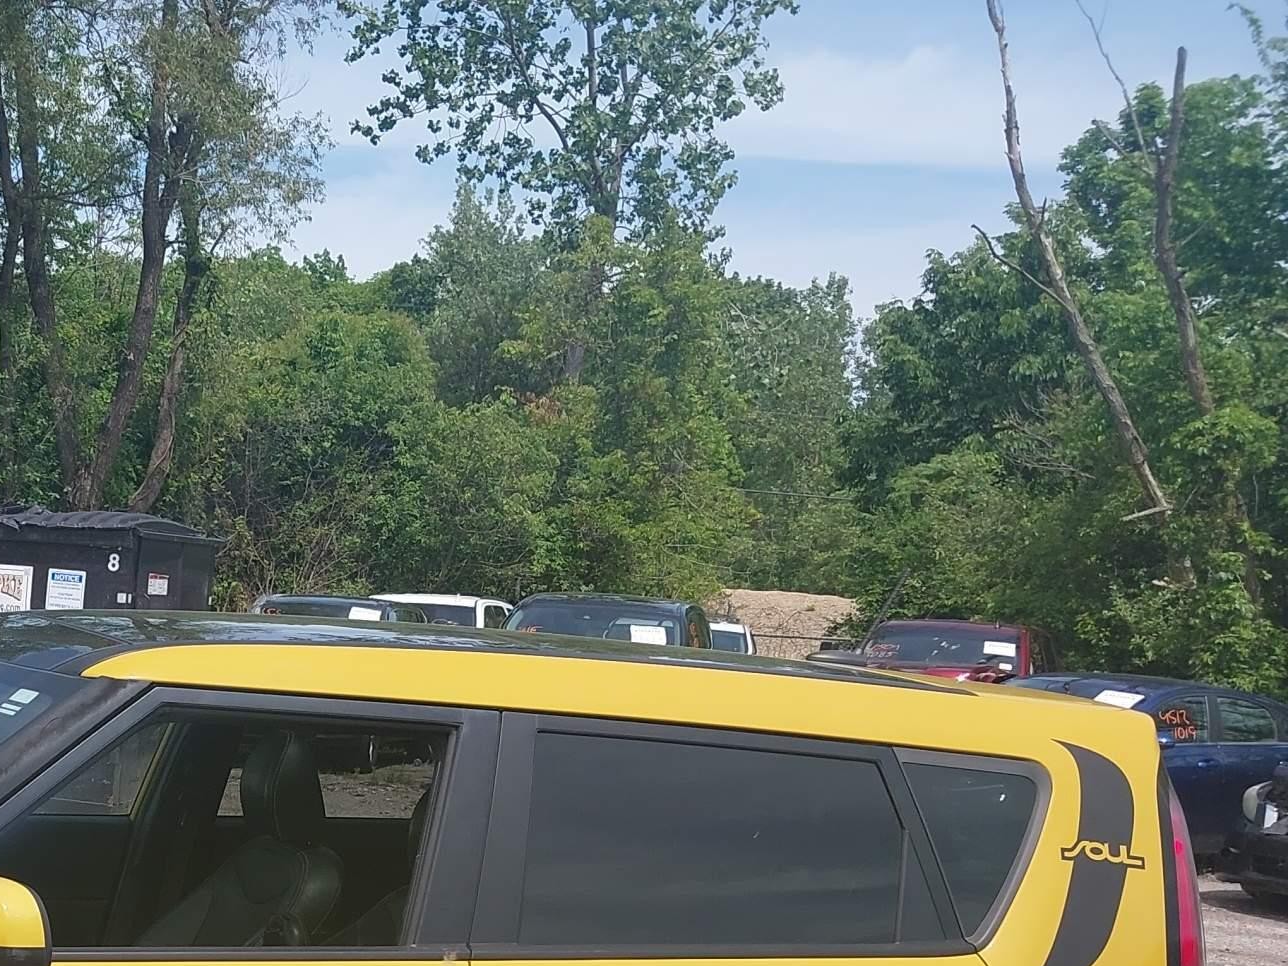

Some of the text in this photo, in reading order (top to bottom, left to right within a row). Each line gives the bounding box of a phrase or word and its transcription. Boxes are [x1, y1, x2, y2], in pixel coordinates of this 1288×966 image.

[108, 553, 120, 572] 8
[54, 573, 80, 583] NOTICE
[1174, 725, 1196, 740] 1019
